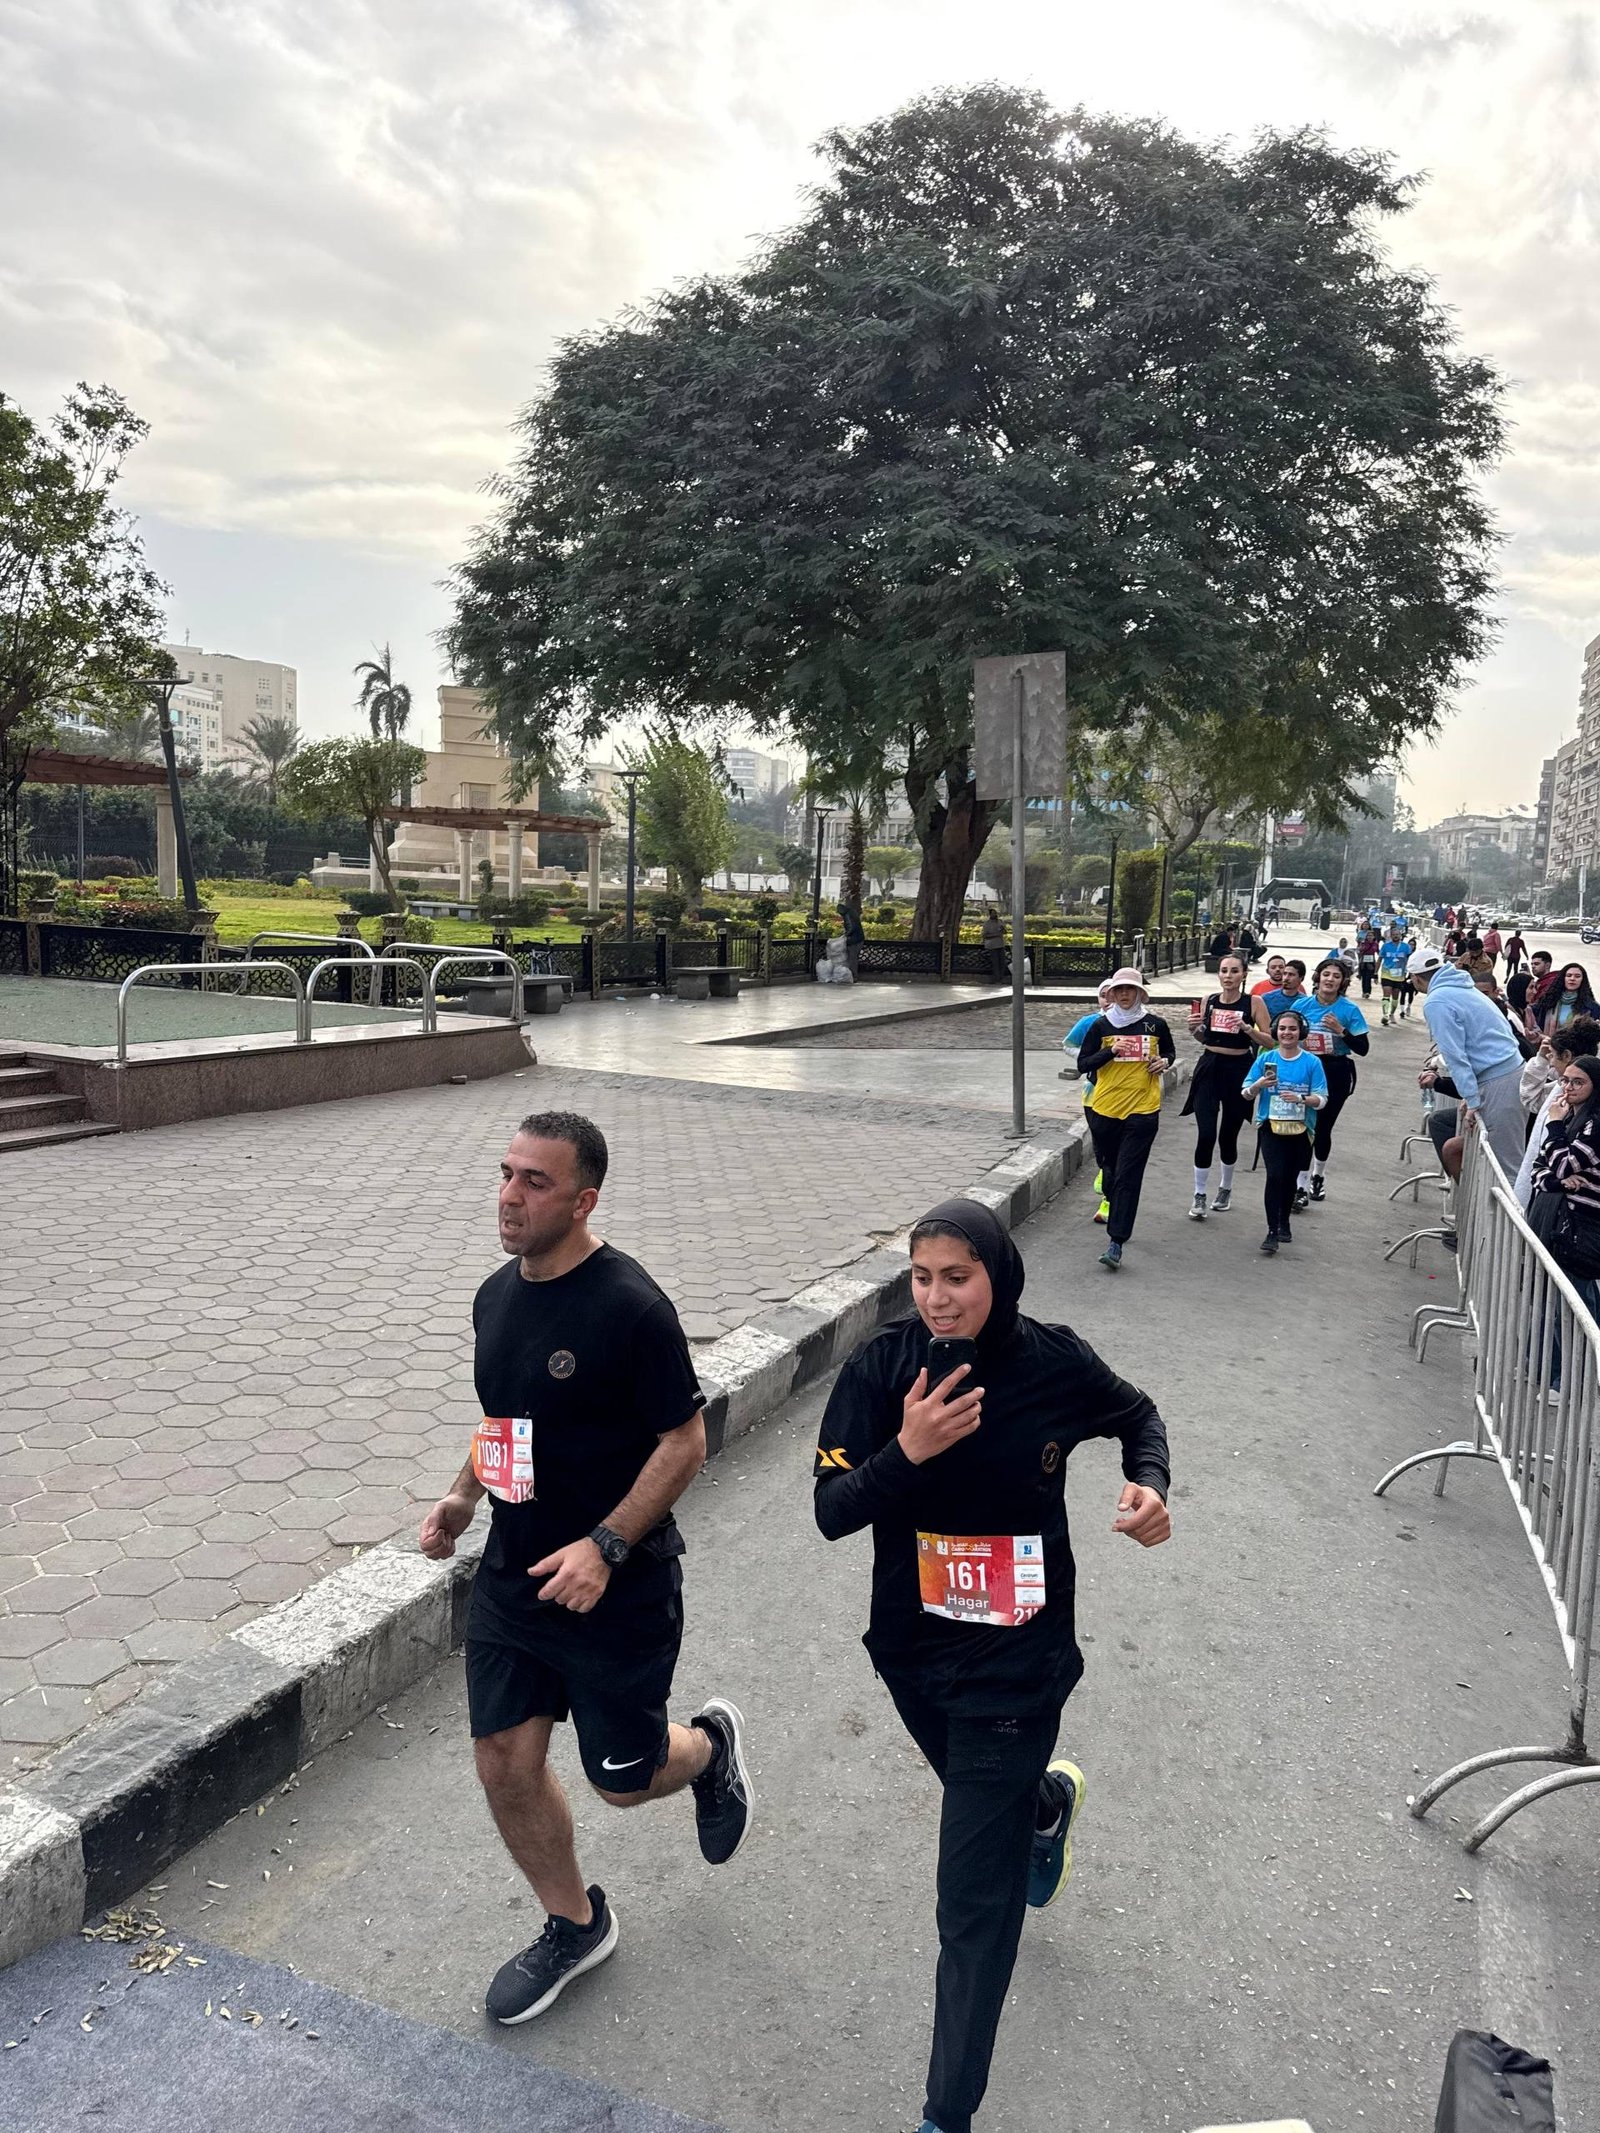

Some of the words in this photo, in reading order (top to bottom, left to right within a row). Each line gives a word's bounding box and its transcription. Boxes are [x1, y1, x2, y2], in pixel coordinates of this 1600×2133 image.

[1274, 1102, 1292, 1111] 2344
[511, 1483, 532, 1503] 21K
[922, 1539, 928, 1550] B
[946, 1561, 987, 1591] 161
[947, 1594, 989, 1610] Hagar
